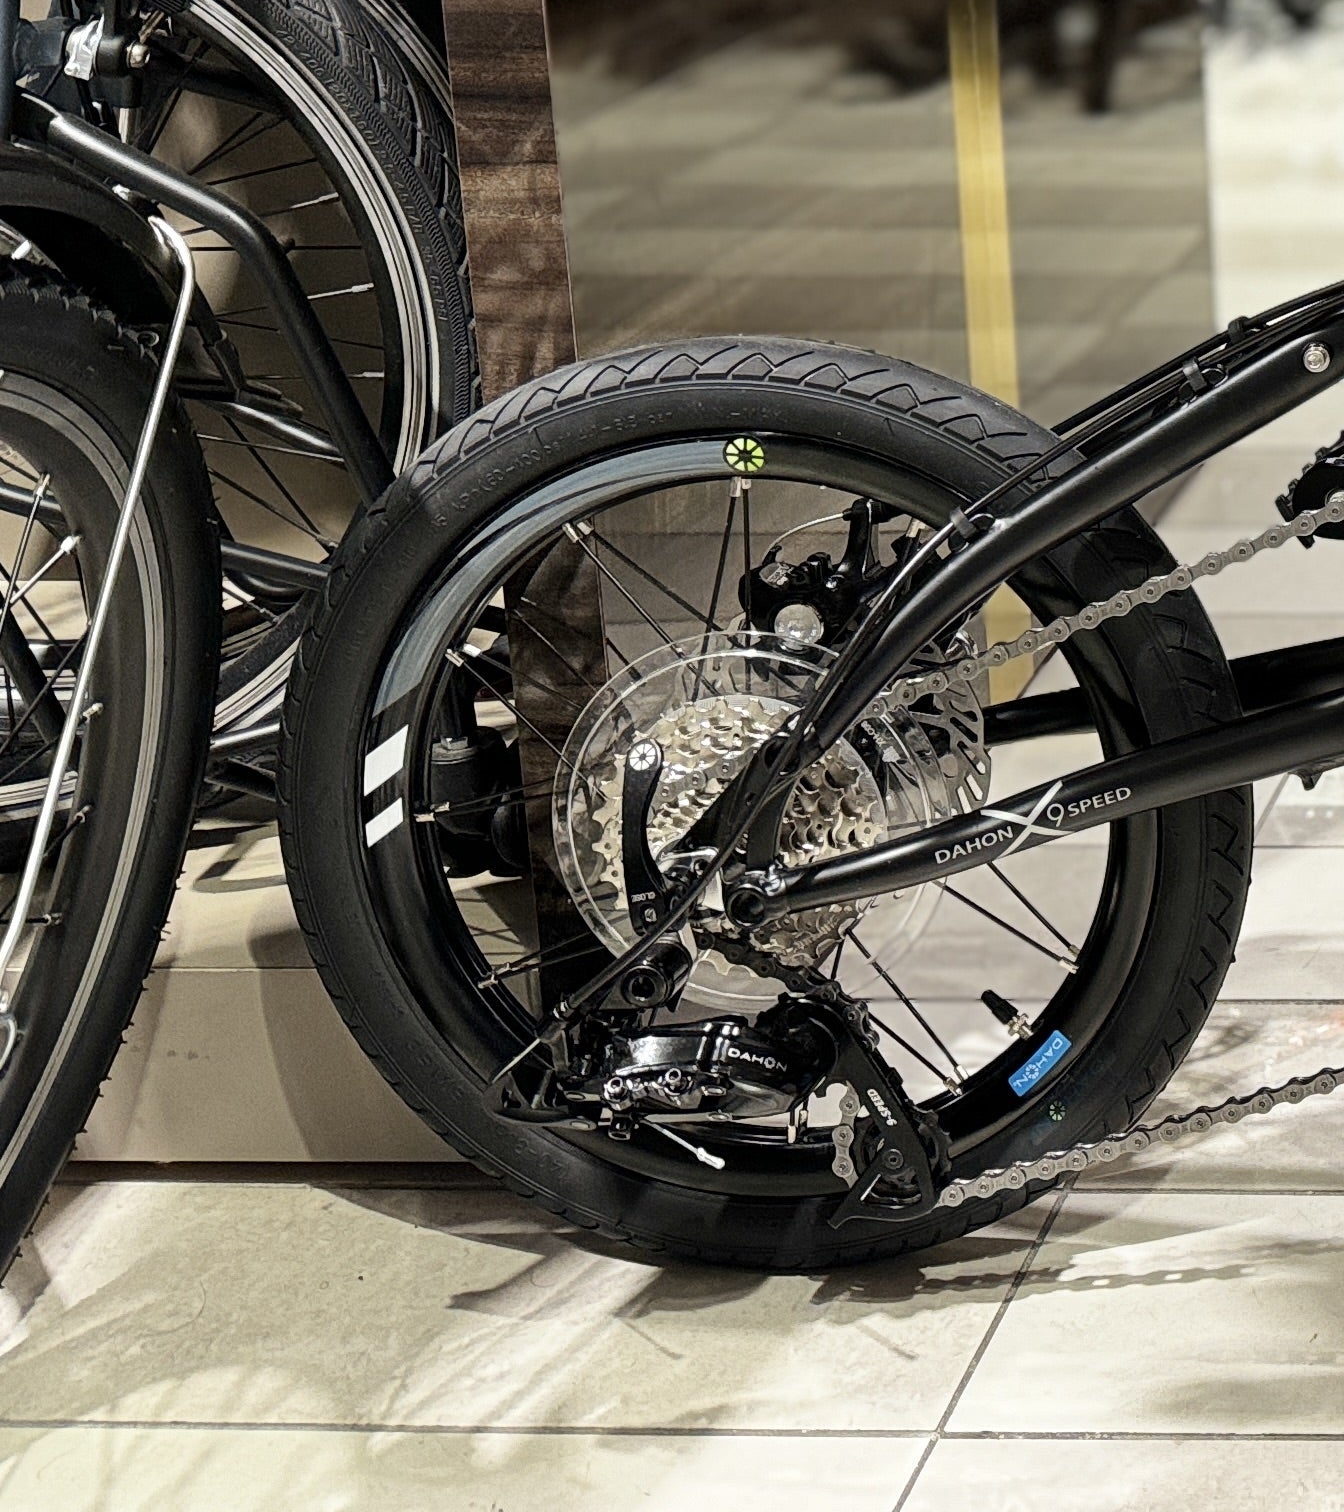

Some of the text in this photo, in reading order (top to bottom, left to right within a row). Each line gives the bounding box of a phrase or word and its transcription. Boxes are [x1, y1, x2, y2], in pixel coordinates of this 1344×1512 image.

[935, 825, 1014, 865] DAHON
[1068, 786, 1132, 819] SPEED
[727, 1046, 788, 1073] DAHON
[1013, 1035, 1063, 1090] DAHON
[865, 1087, 899, 1128] 9-SPEED
